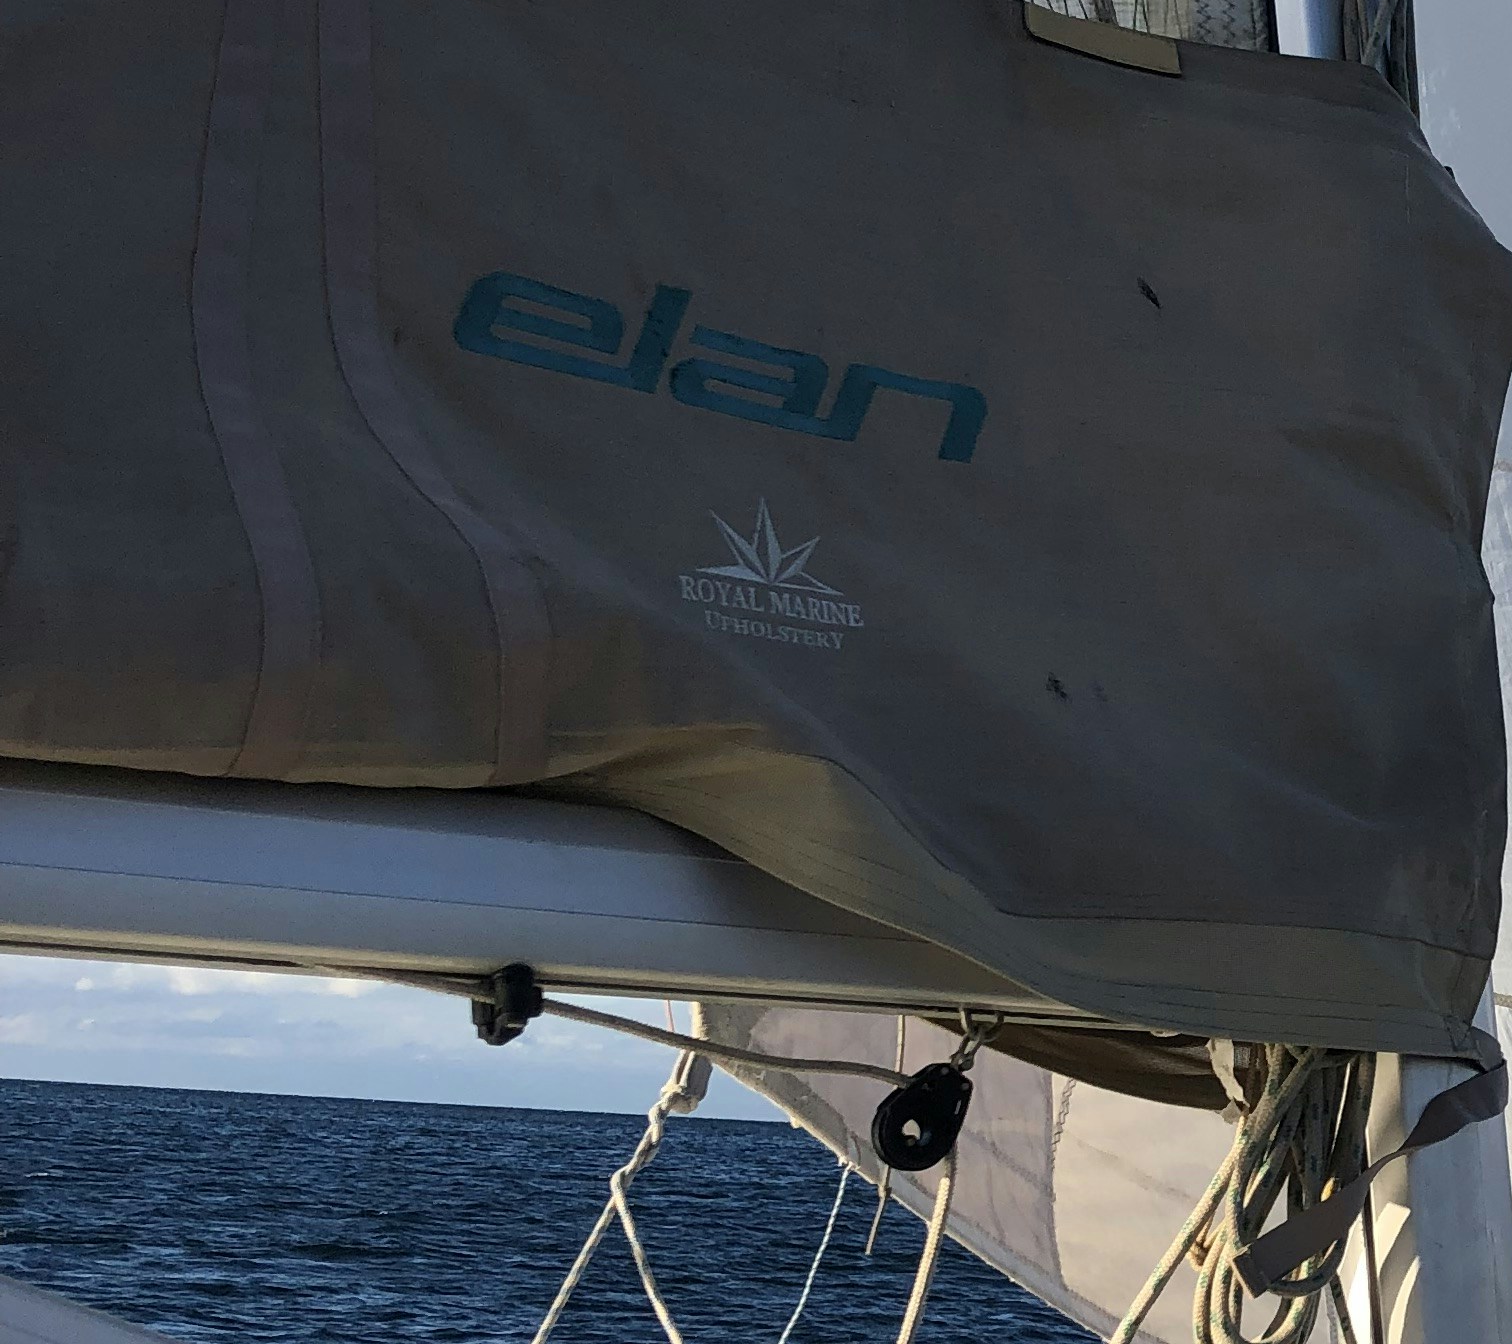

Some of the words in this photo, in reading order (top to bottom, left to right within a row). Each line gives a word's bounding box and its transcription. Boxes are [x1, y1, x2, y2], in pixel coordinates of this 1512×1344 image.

[453, 270, 988, 464] elan
[679, 575, 765, 612] ROYAL
[770, 591, 865, 627] MARINE
[704, 610, 845, 650] UPHOLSTERY
